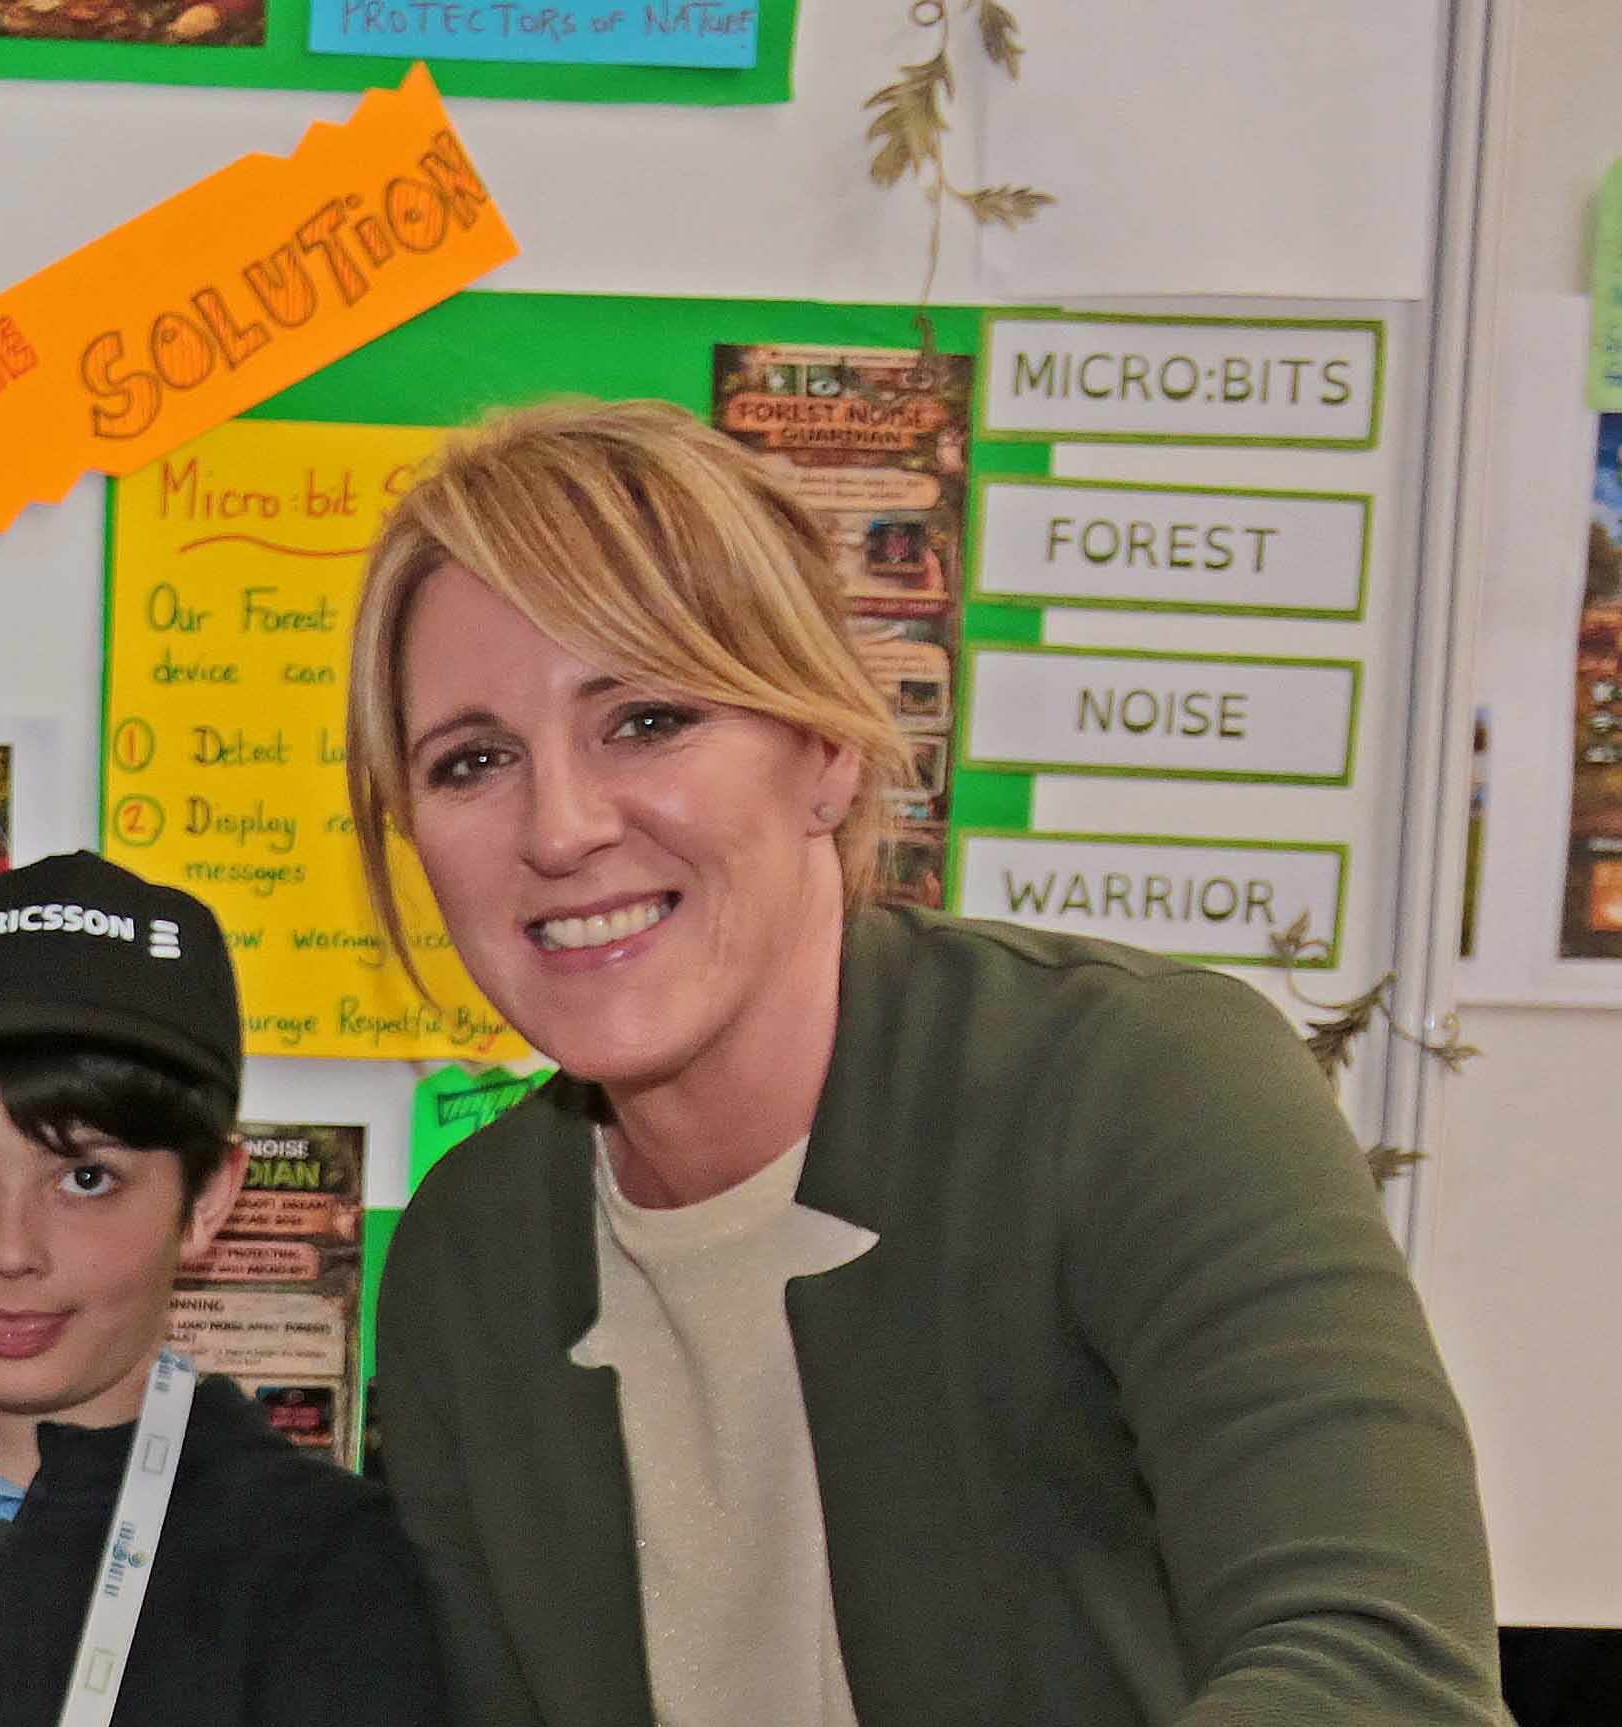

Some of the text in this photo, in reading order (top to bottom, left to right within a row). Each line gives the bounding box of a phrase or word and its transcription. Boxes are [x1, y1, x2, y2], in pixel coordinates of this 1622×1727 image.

[1011, 352, 1352, 407] MICRO:BITS
[1045, 518, 1279, 574] FOREST
[148, 581, 339, 632] Our Forest
[152, 660, 335, 686] device can
[1077, 687, 1249, 739] NOISE
[194, 726, 289, 766] Detect
[185, 798, 299, 852] Display
[1002, 870, 1276, 926] WARRIOR
